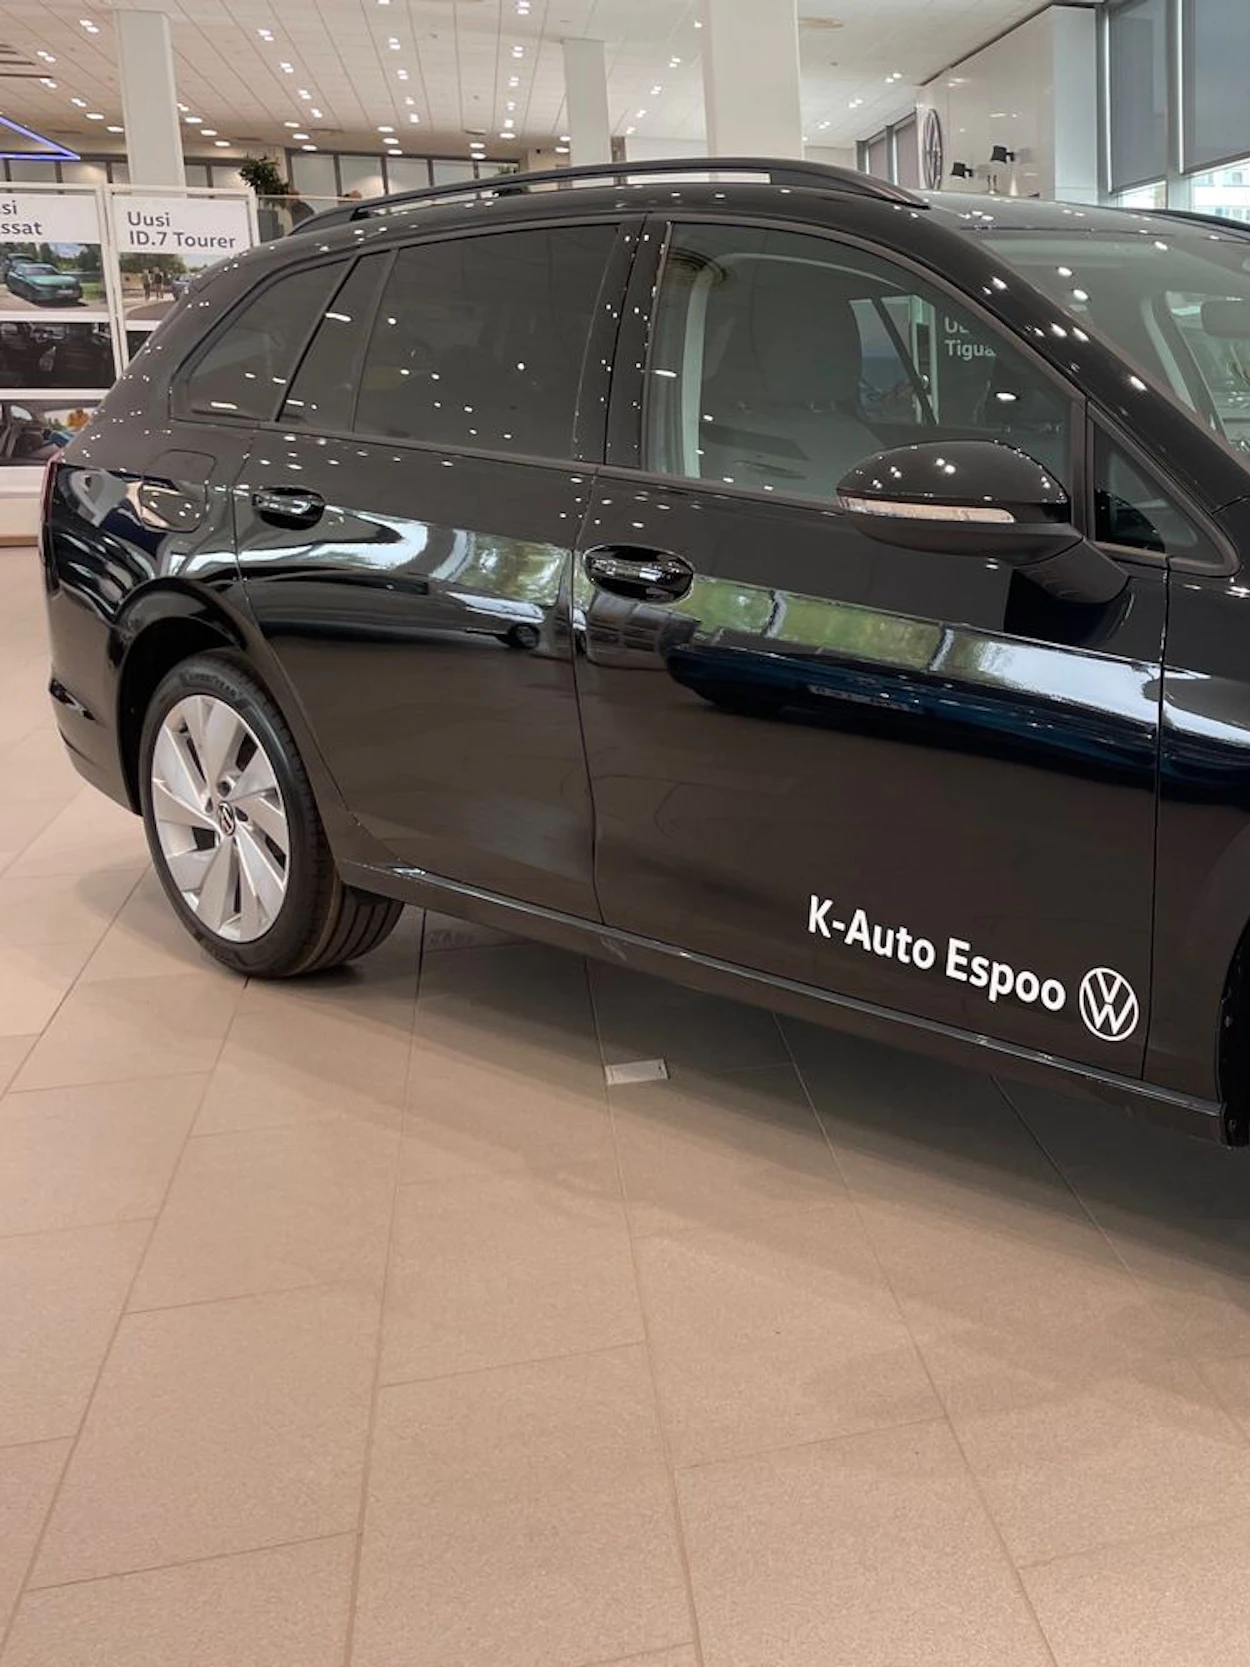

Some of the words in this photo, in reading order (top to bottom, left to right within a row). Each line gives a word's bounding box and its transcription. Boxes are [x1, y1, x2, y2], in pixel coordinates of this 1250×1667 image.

[127, 211, 170, 228] Uusi
[129, 230, 167, 246] ID.7
[173, 232, 236, 248] Tourer
[808, 895, 936, 970] K-Auto
[945, 937, 1066, 1012] Espoo
